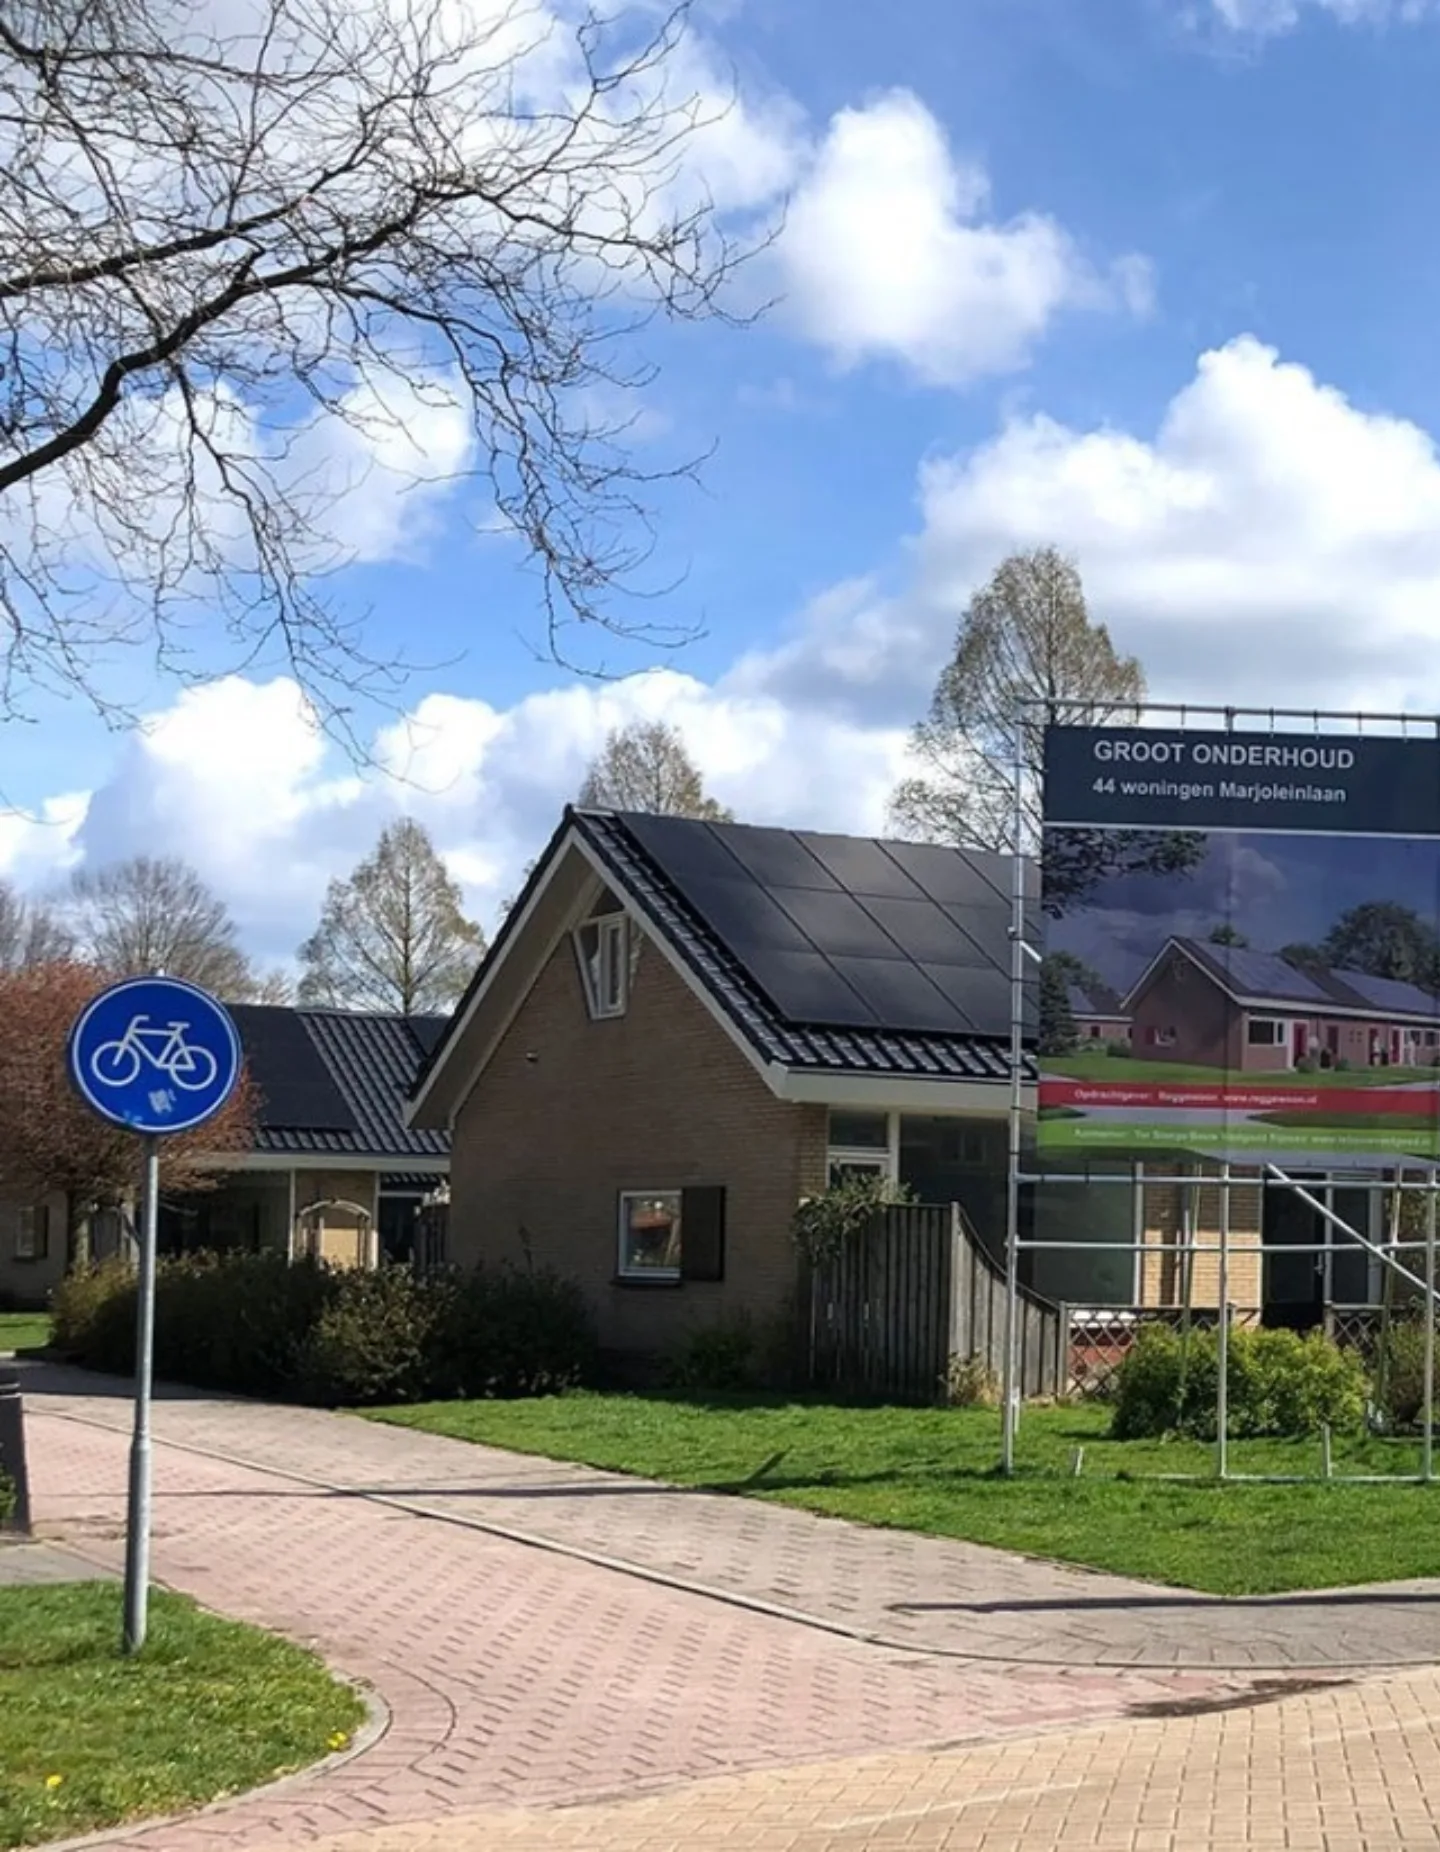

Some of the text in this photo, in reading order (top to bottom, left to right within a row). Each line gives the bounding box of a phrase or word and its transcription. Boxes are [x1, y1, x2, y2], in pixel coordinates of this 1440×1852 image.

[1094, 740, 1354, 769] GROOT ONDERHOUD
[1093, 777, 1346, 803] 44 woningen Marjoleinlaan
